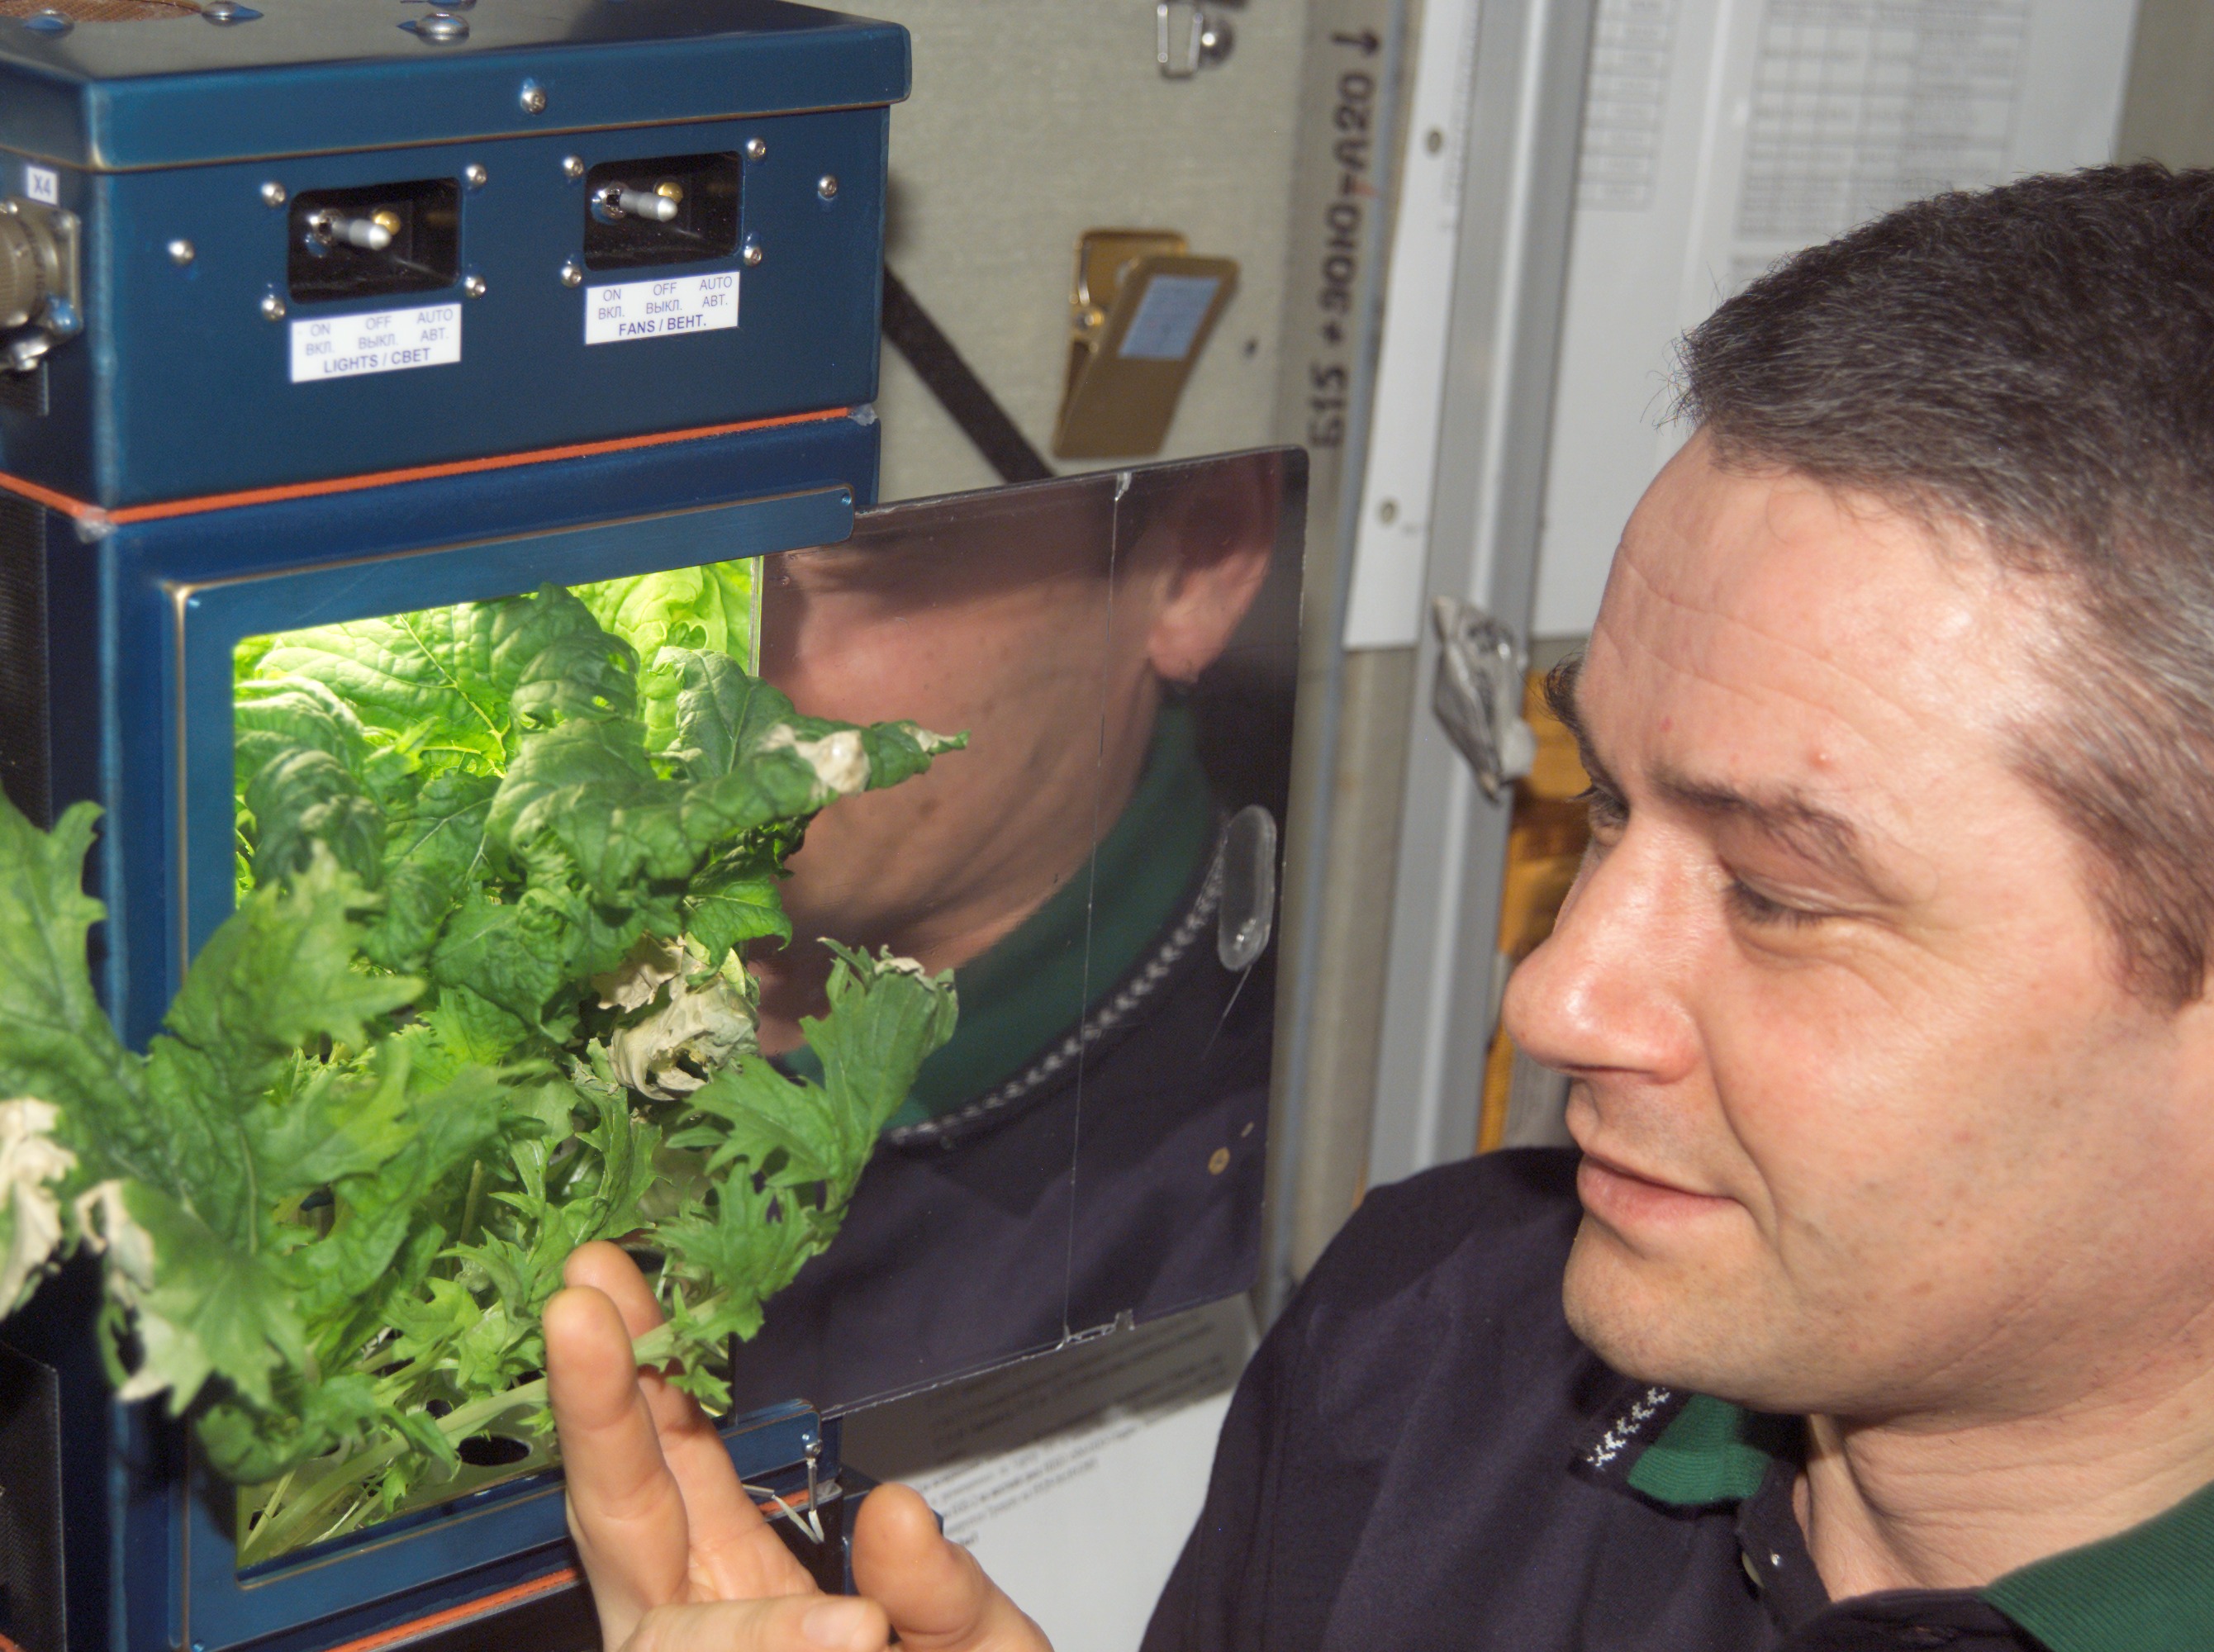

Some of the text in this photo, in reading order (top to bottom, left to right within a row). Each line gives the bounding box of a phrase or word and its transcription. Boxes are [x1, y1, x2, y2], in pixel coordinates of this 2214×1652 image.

[33, 173, 51, 197] X4
[603, 276, 733, 301] ON OFF AUTO
[598, 294, 728, 320] ВКЛ. ВЫКЛ. АВТ.
[310, 308, 454, 337] ON OFF AUTO
[619, 314, 706, 336] FANS / ВЕНТ.
[306, 327, 449, 356] ВКЛ. ВЫКЛ. АВТ.
[324, 348, 431, 373] LIGHTS / СВЕТ
